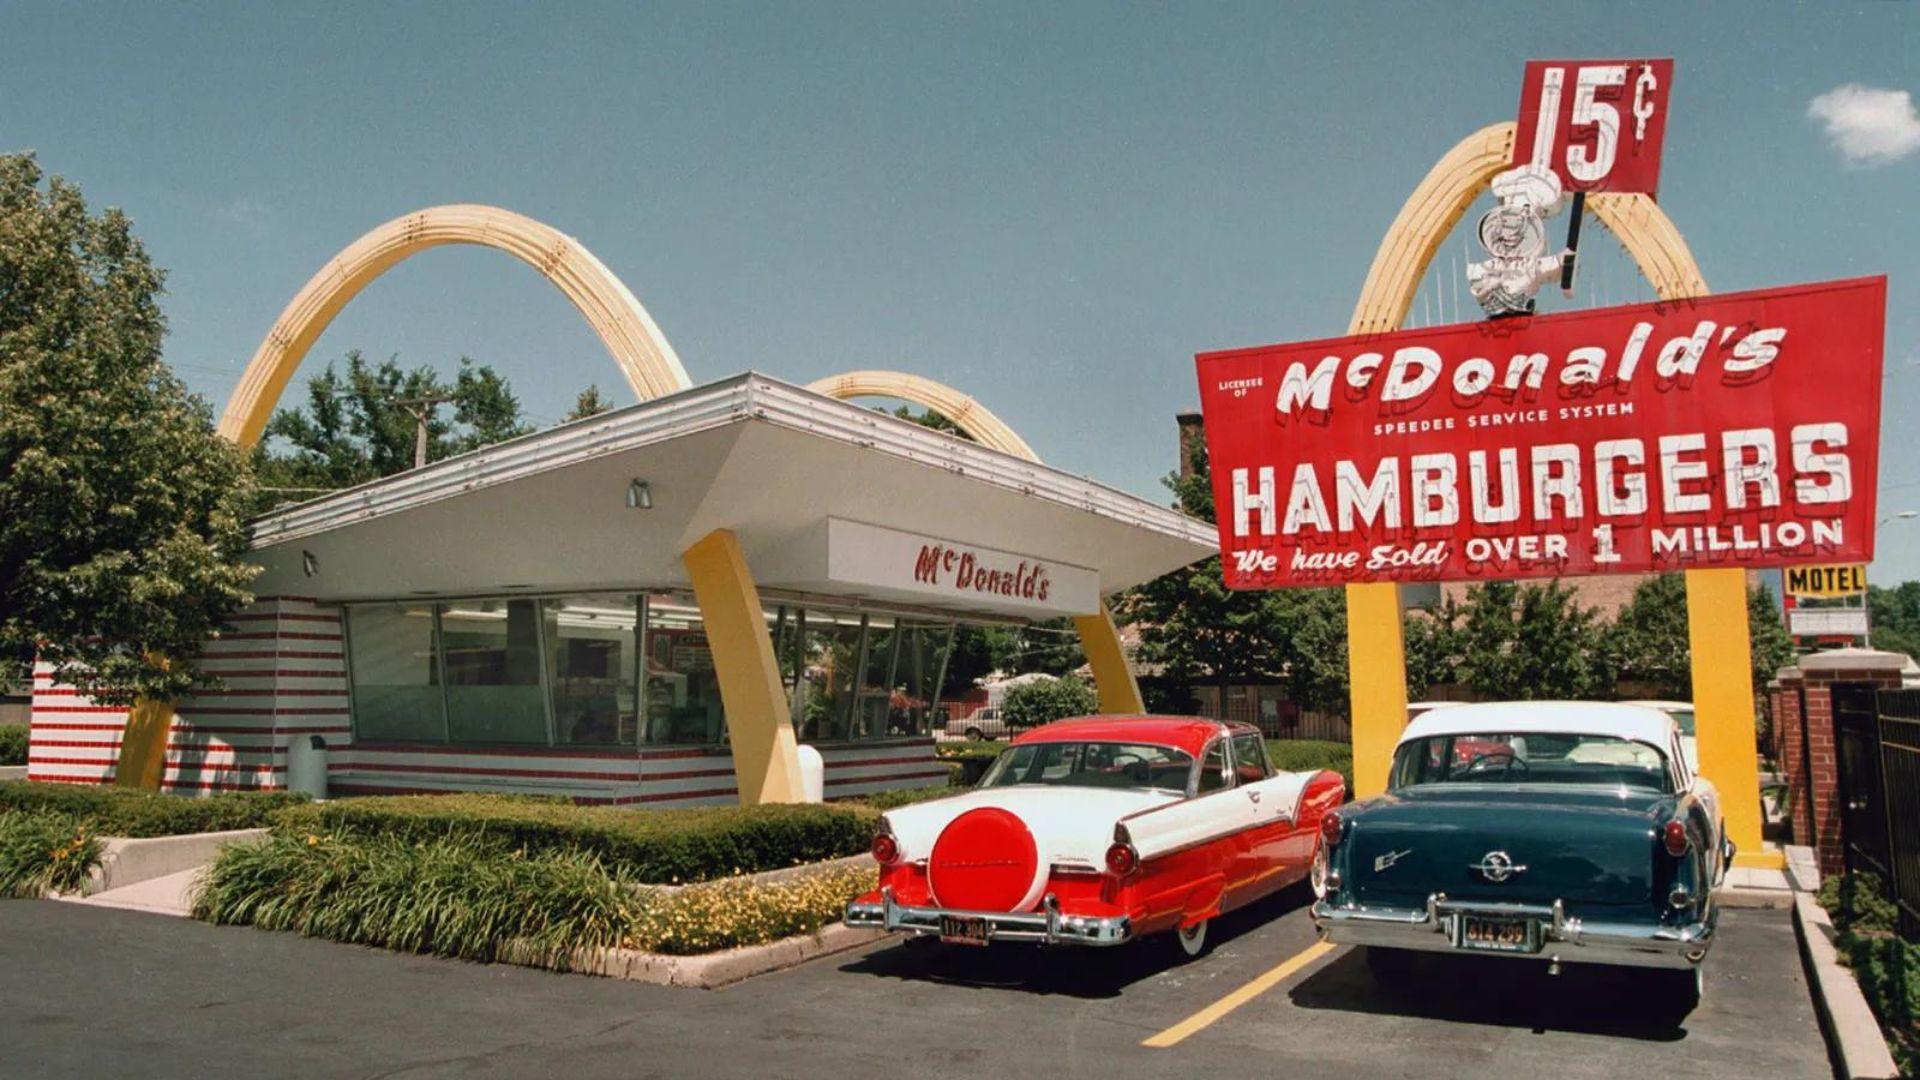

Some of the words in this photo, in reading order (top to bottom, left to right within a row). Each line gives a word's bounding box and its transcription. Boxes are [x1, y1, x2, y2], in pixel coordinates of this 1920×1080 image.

[1530, 63, 1657, 181] 15¢
[1276, 321, 1788, 415] McDonald's
[1373, 418, 1455, 436] SPEEDEE
[1467, 409, 1549, 428] SERVICE
[1559, 402, 1634, 420] SYSTEM
[1231, 422, 1853, 537] HAMBURGERS
[914, 545, 1050, 601] McDonald's
[1232, 550, 1277, 572] We
[1291, 546, 1361, 570] have
[1366, 540, 1449, 571] Sold
[1466, 533, 1568, 562] OVER
[1592, 522, 1622, 564] 1
[1650, 518, 1844, 553] MILLION
[1788, 566, 1863, 593] MOTEL
